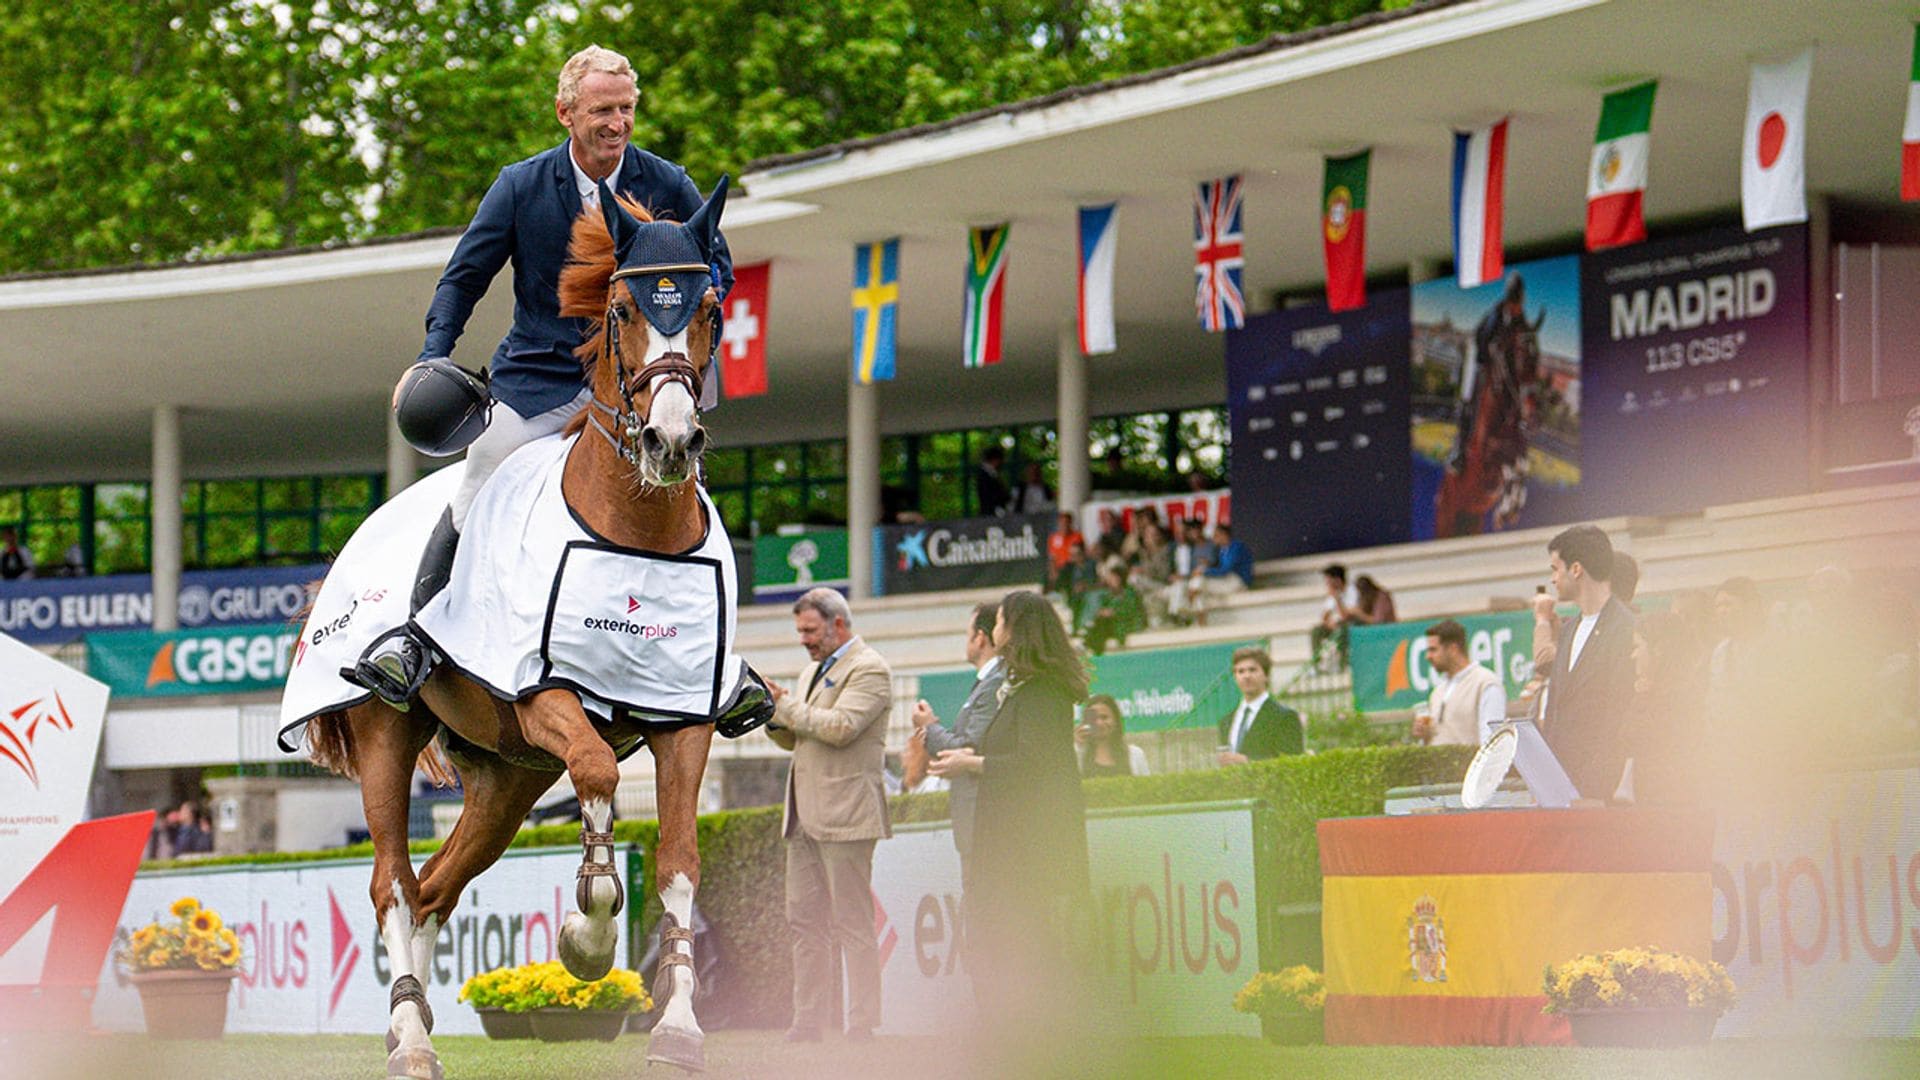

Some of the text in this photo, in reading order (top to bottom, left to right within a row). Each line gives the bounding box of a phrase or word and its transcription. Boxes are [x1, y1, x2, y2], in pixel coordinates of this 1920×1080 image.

[1610, 268, 1776, 342] MADRID
[1646, 343, 1683, 374] 113
[927, 525, 1039, 567] CaixaBank
[60, 593, 153, 628] EULEN
[210, 584, 304, 621] GRUPO
[584, 617, 677, 639] exteriorplus
[175, 634, 299, 684] caser
[1410, 628, 1512, 691] cer
